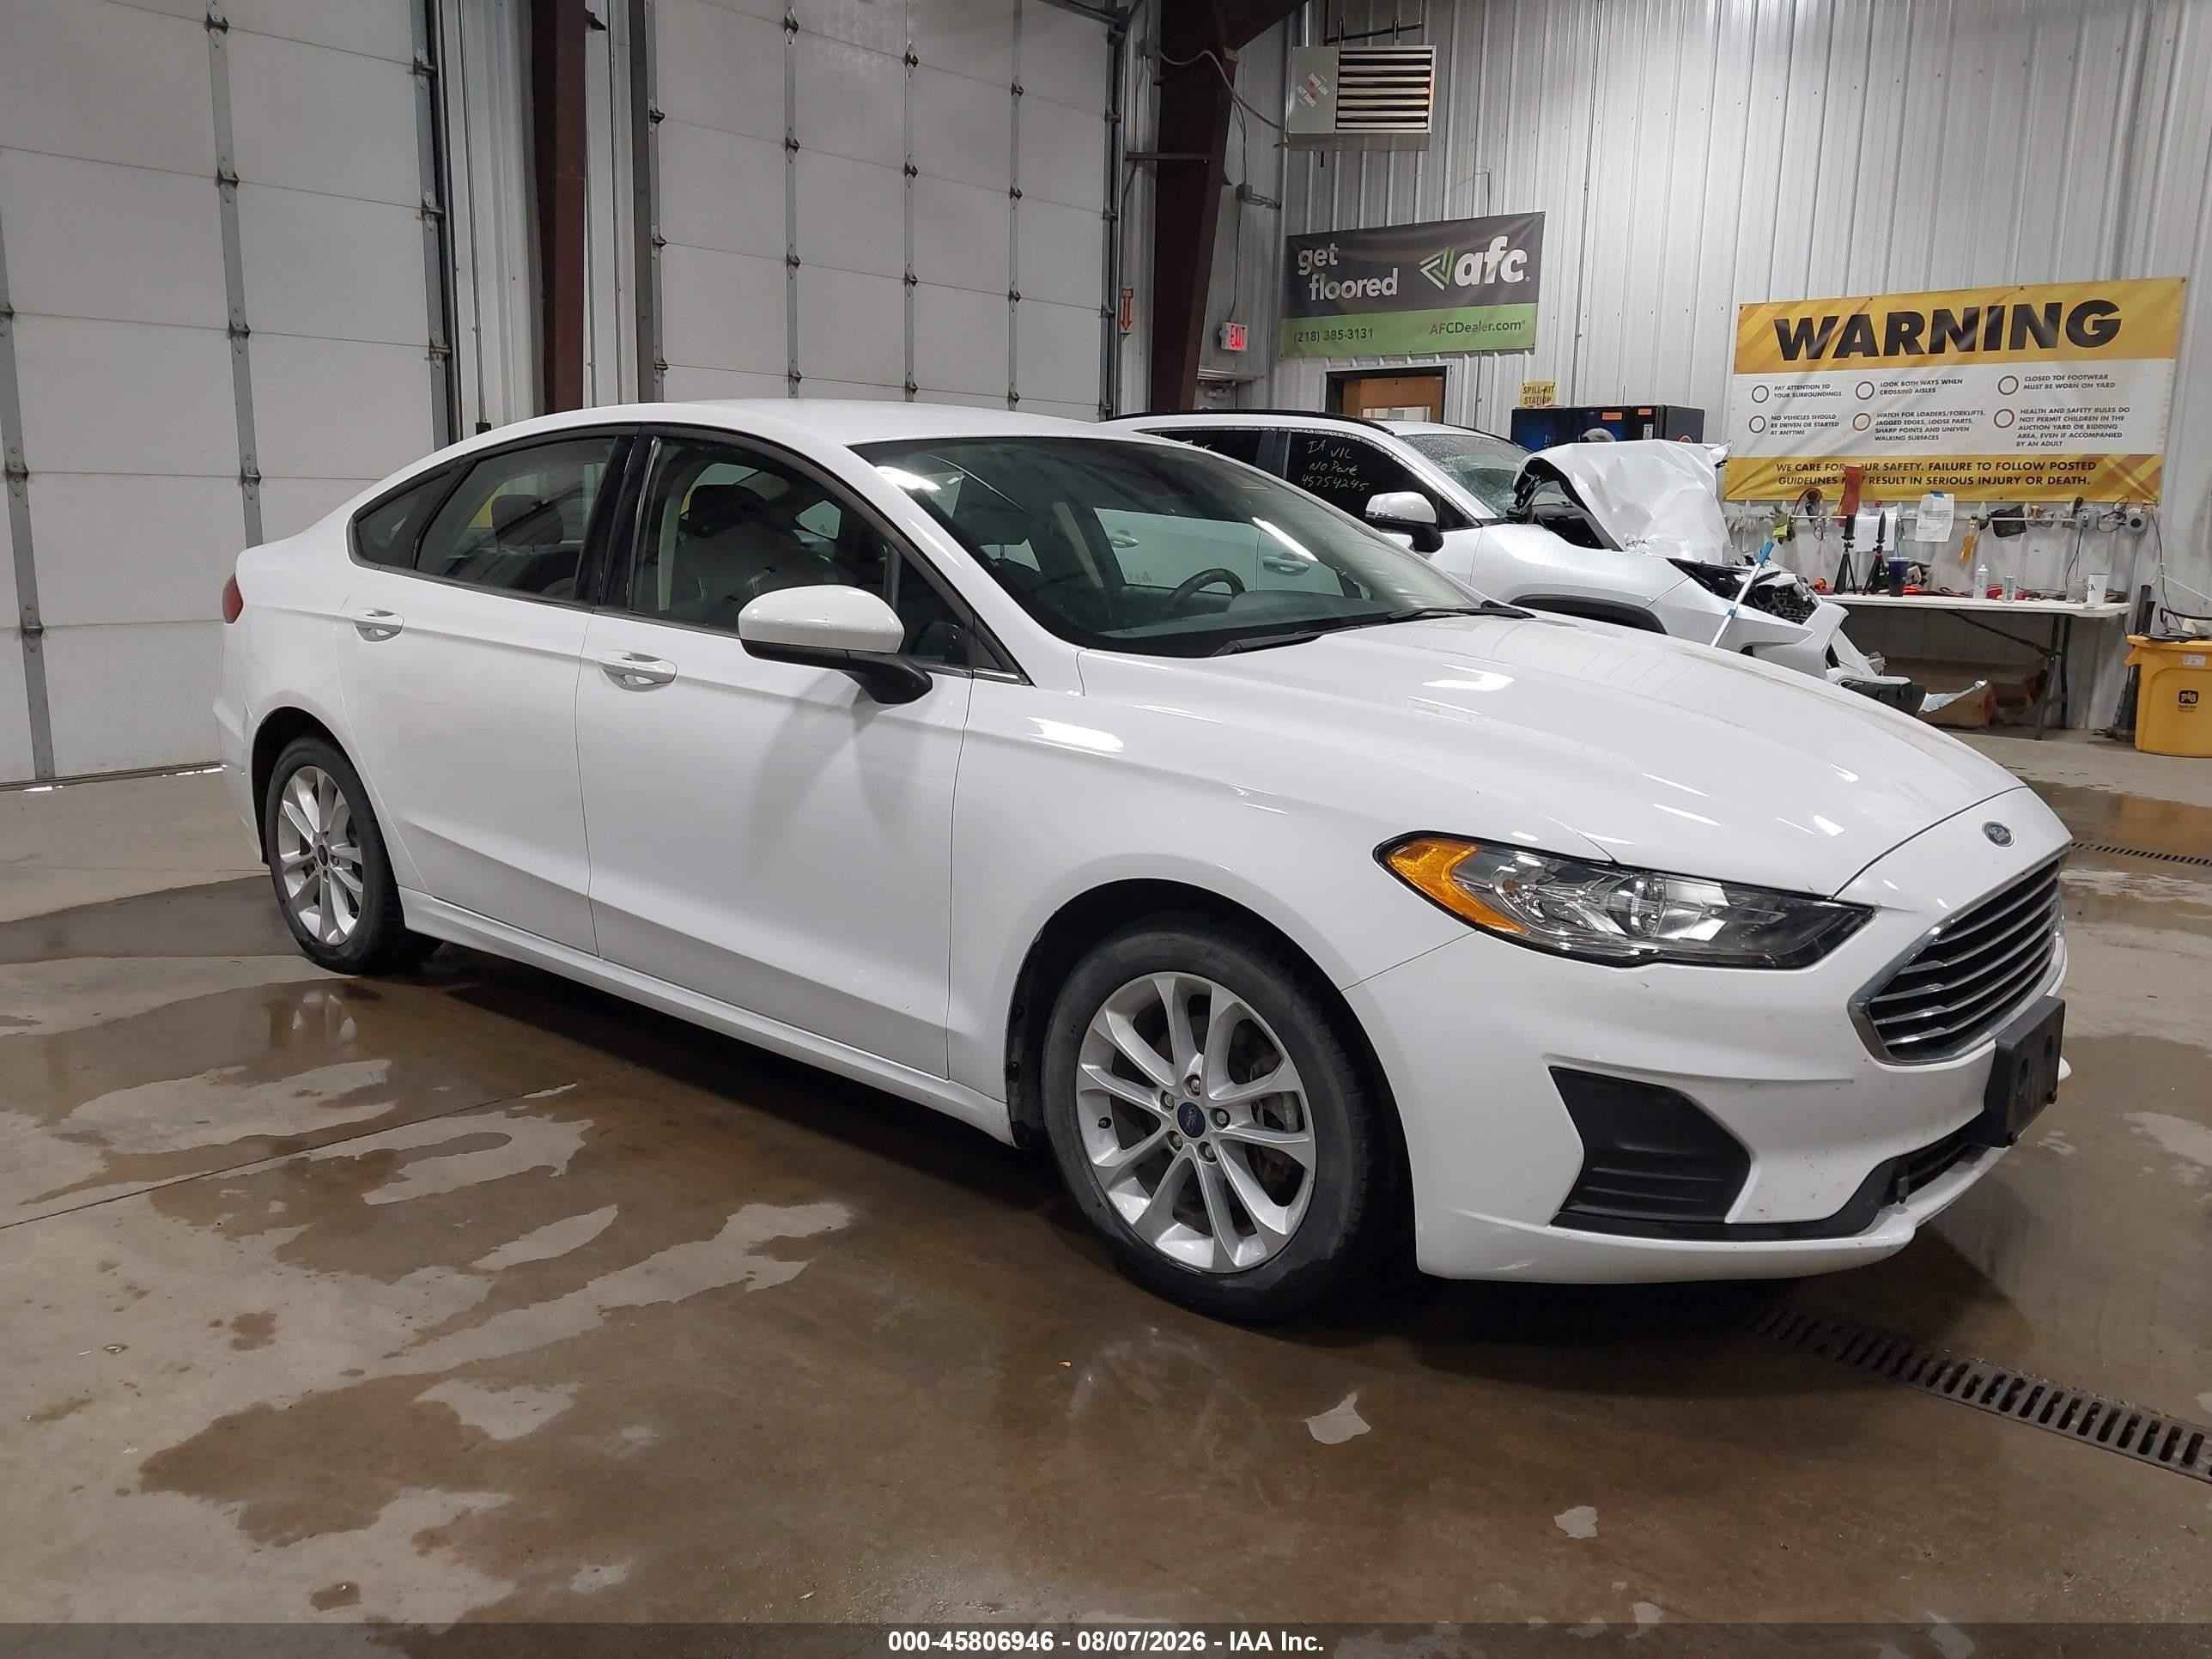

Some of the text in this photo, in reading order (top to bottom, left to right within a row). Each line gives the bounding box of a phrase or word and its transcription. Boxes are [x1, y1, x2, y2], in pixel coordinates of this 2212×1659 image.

[1297, 242, 1340, 276] get
[1309, 268, 1398, 301] floored
[1295, 328, 1373, 343] (218) 385-3131
[1773, 300, 2122, 361] WARNING
[1795, 463, 1821, 471] CARE
[1883, 462, 1924, 471] SAFETY.
[1929, 462, 1972, 471] FAILURE
[1977, 462, 1991, 471] TO
[1996, 462, 2045, 471] FOLLOW
[2050, 461, 2097, 471] POSTED
[1779, 476, 1838, 485] GUIDELINES
[1869, 476, 1907, 485] RESULT
[1926, 477, 1973, 485] SERIOUS
[1978, 476, 2021, 485] INJURY
[2026, 477, 2044, 485] OR
[2047, 477, 2091, 485] DEATH.
